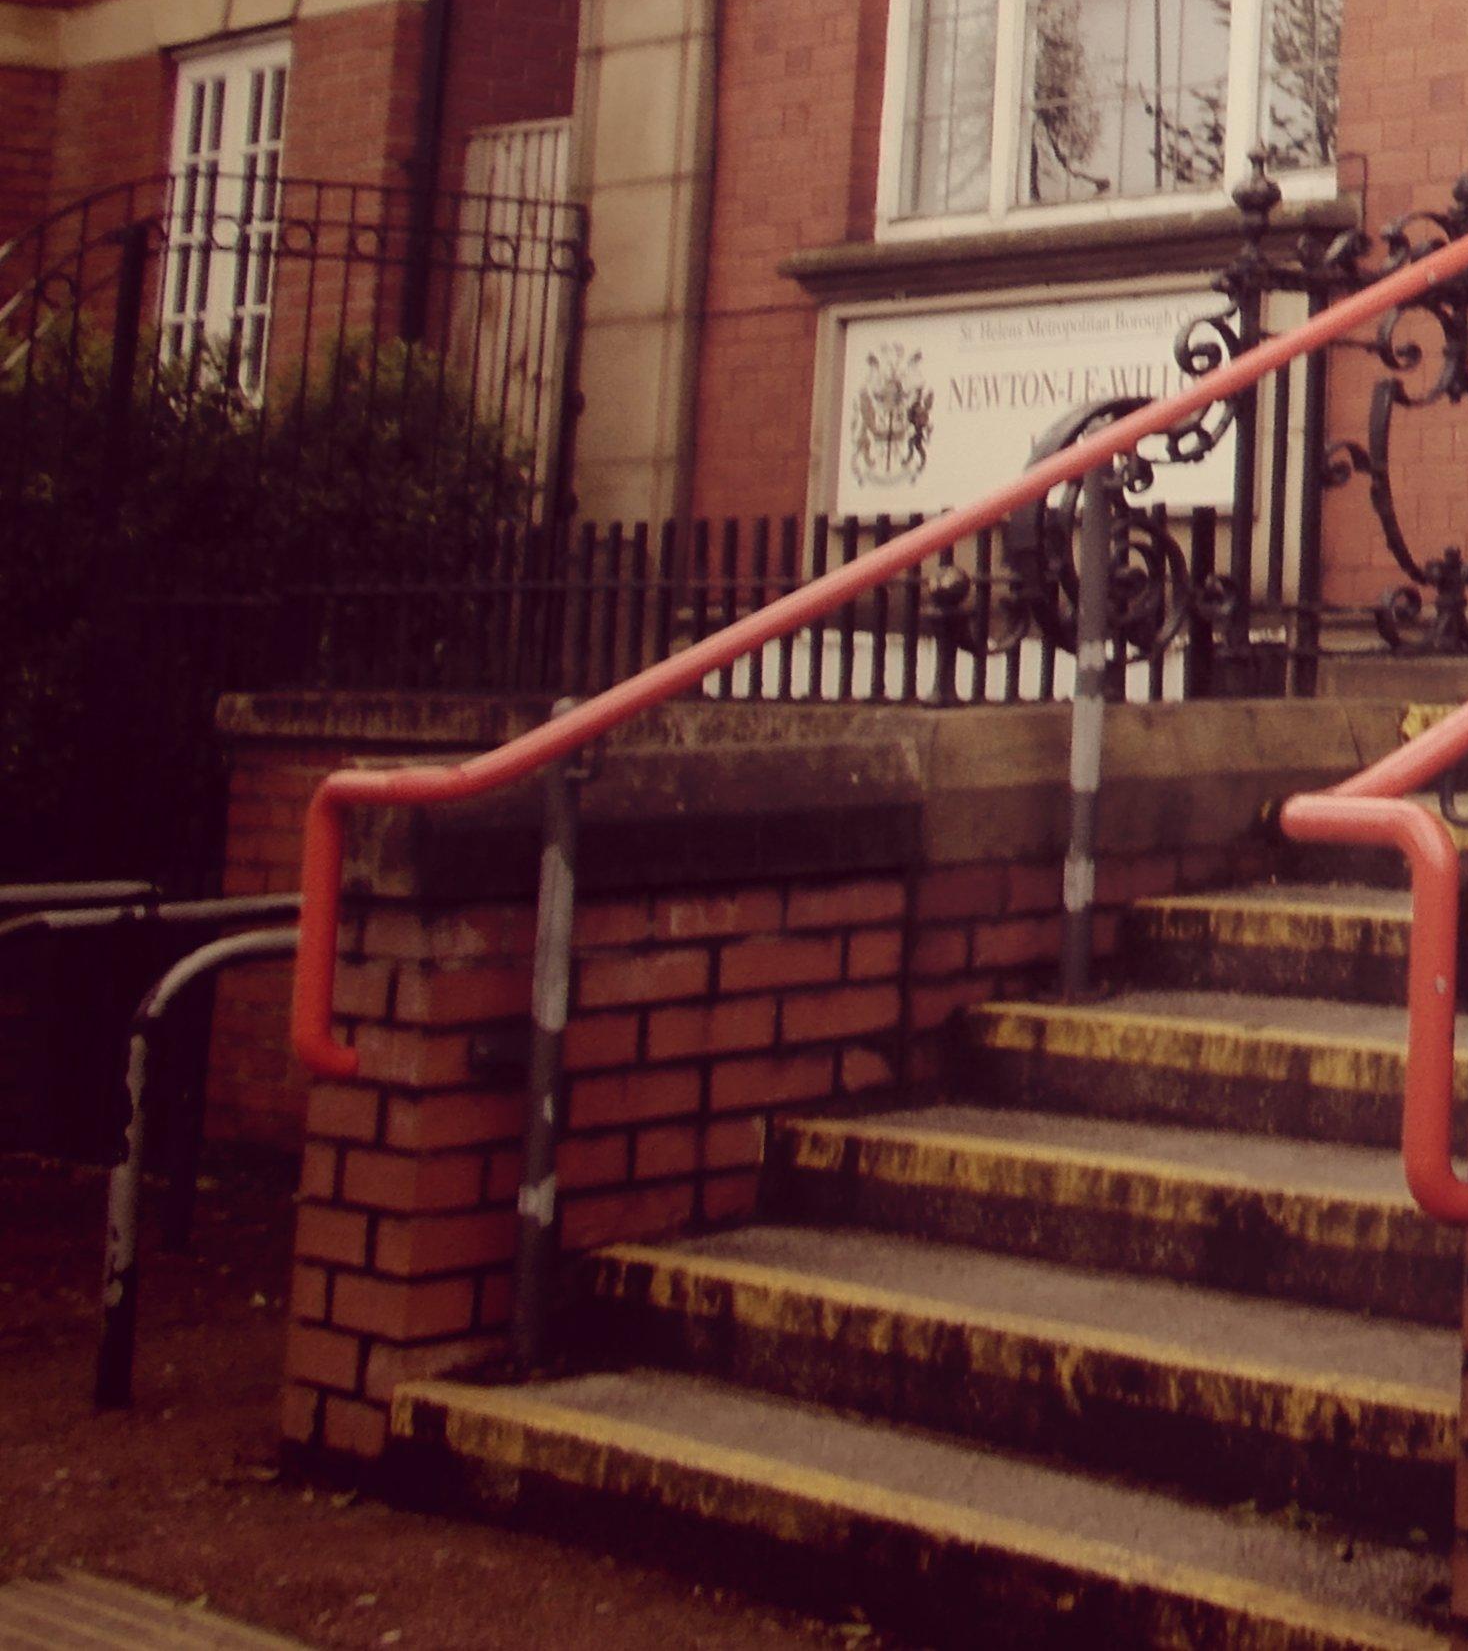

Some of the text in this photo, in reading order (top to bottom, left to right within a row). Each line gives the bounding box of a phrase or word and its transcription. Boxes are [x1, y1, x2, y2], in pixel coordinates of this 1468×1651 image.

[980, 319, 1023, 341] Helens
[1027, 311, 1111, 340] Metropolitan
[1115, 308, 1172, 334] Borough
